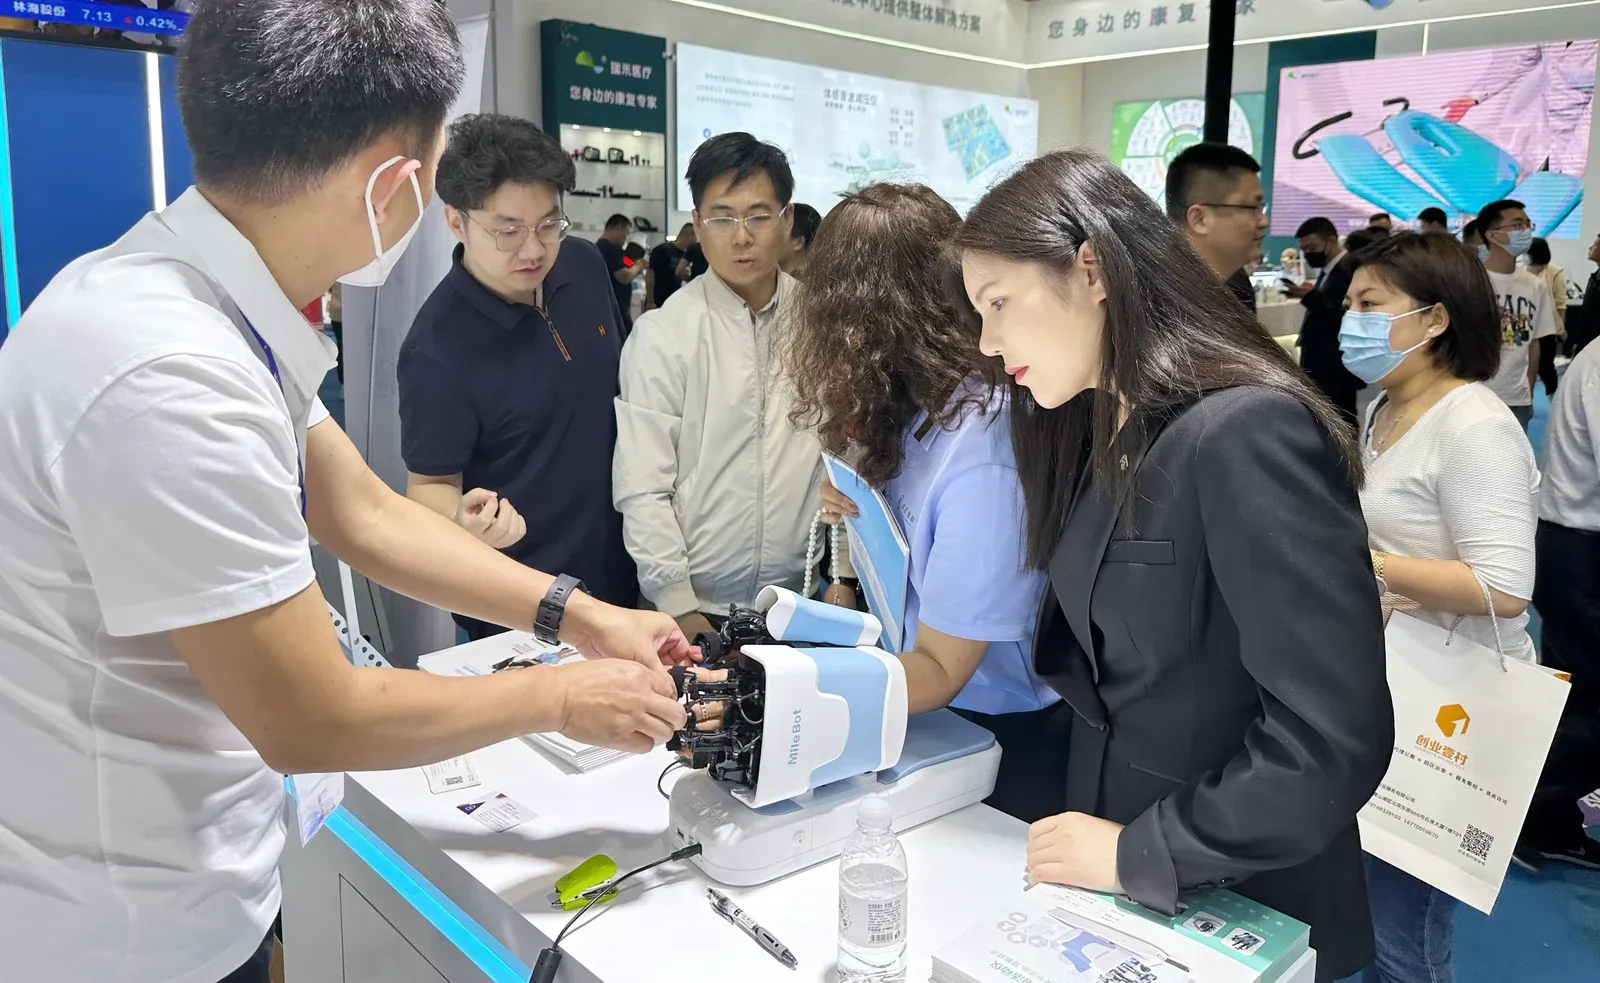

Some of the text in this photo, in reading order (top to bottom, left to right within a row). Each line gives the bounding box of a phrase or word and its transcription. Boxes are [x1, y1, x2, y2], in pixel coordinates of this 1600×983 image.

[13, 1, 177, 30] 林海股份 7.13 0.42%
[829, 0, 981, 33] 中心提供整体解决方案
[1048, 0, 1256, 39] 您身边的康复家
[569, 85, 657, 109] 您身边的康复专家
[1495, 294, 1537, 331] ACE
[788, 709, 802, 765] MileBot
